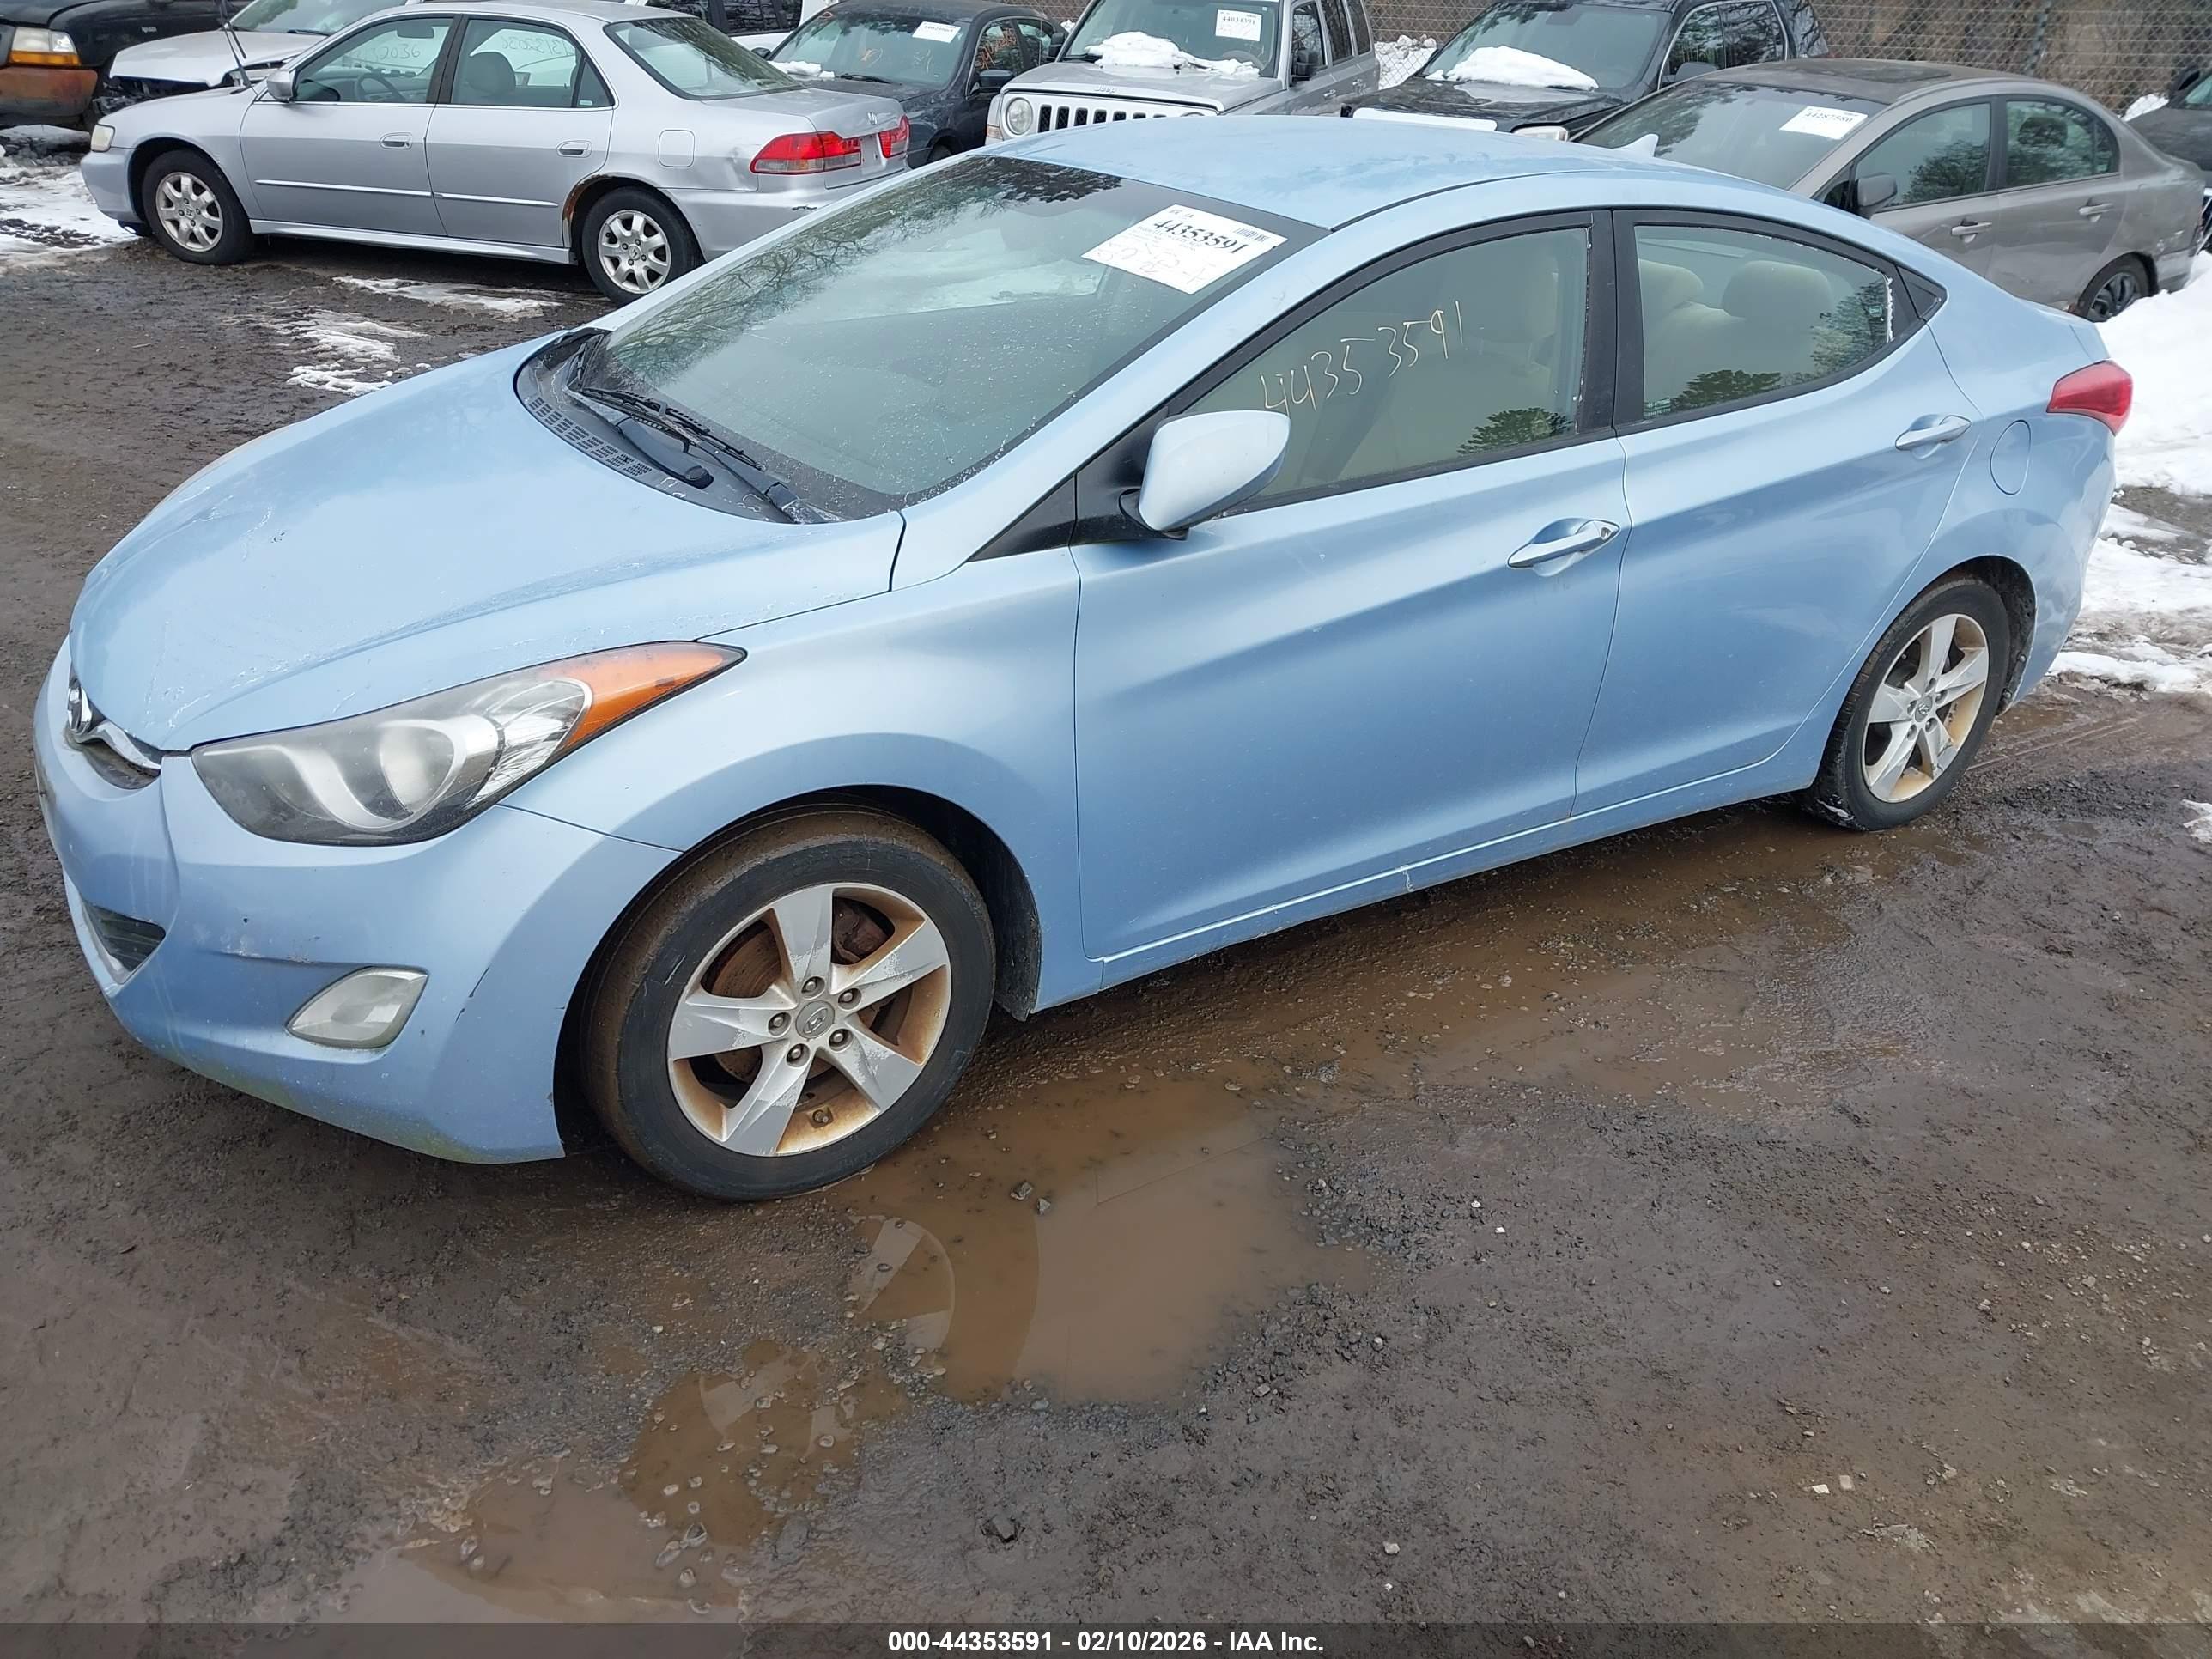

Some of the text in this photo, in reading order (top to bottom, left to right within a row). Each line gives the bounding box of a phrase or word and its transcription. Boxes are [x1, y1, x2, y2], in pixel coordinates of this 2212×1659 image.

[1095, 85, 1116, 94] Jeep
[1155, 221, 1248, 254] 44353591
[1260, 301, 1463, 414] 44353591
